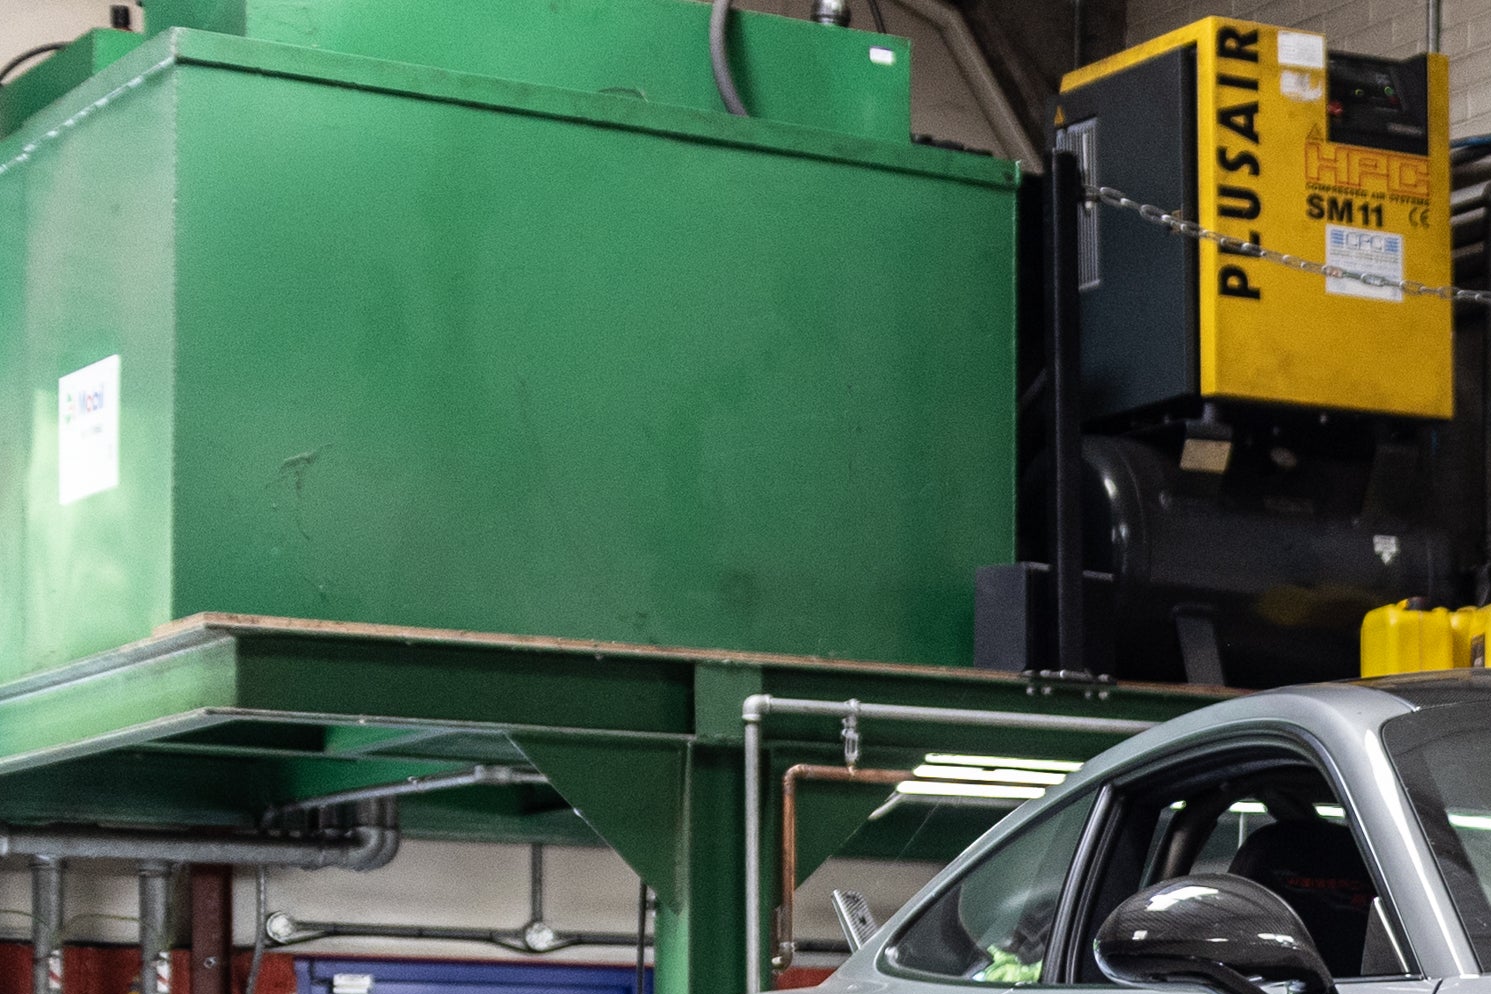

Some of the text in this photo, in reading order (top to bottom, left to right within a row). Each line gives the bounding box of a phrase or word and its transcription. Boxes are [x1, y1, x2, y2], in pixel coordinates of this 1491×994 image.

[1217, 25, 1262, 299] PLUSAIR
[1304, 141, 1430, 199] HPC
[1306, 192, 1353, 224] SM
